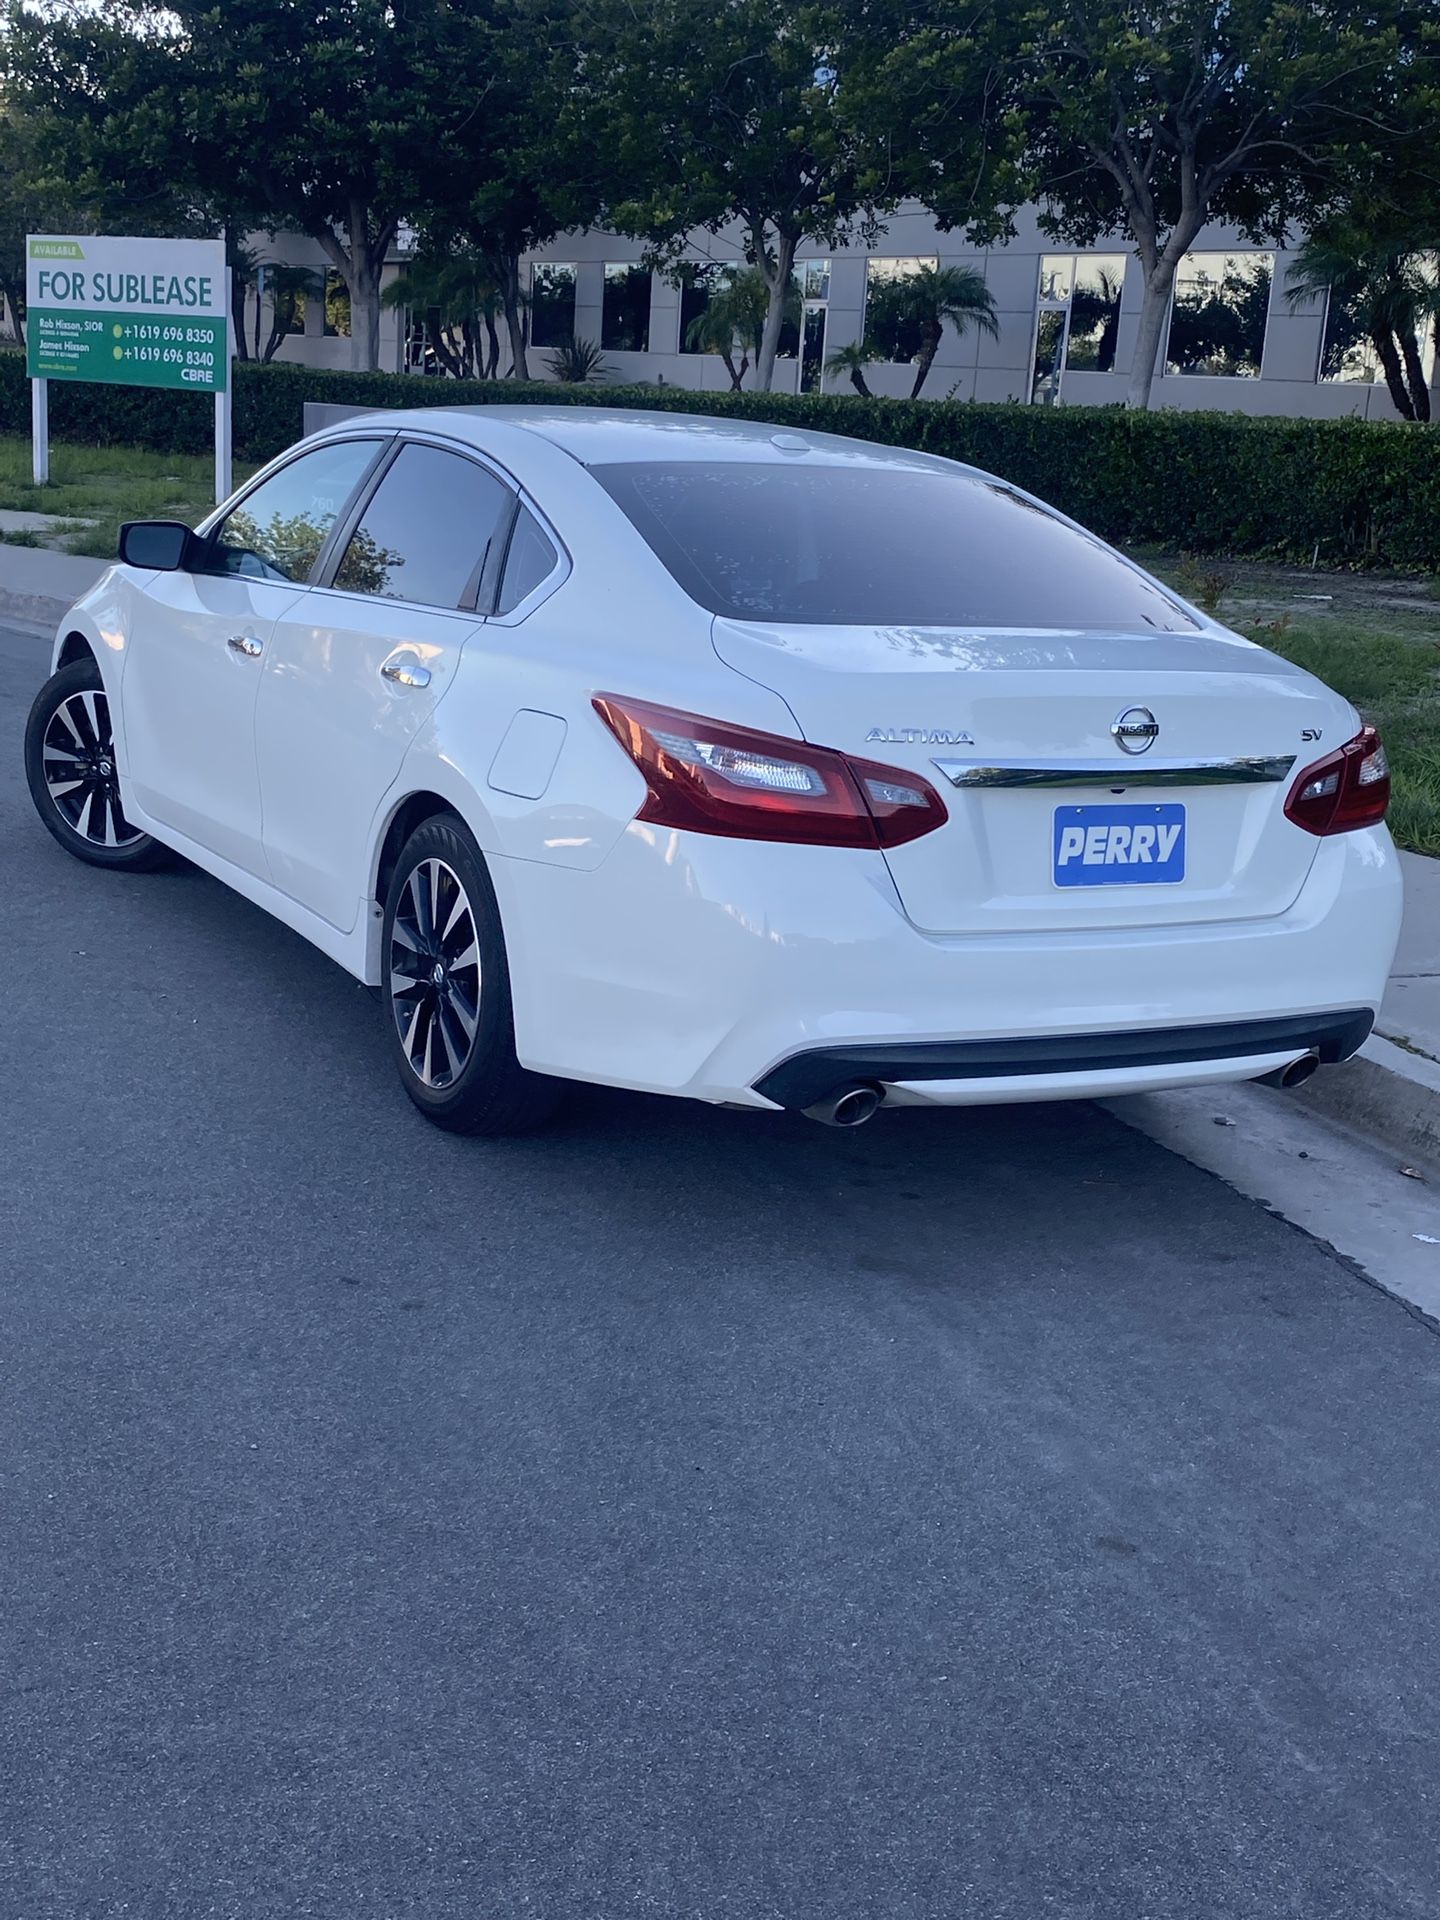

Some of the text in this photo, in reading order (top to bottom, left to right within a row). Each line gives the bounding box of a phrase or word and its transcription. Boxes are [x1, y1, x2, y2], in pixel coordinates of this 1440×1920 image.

[33, 245, 77, 256] AVAILABLE
[38, 271, 212, 307] FOR SUBLEASE
[39, 318, 54, 329] Rob
[84, 321, 104, 332] SIOR
[163, 326, 184, 342] 696
[186, 328, 214, 344] 8350
[39, 339, 63, 350] James
[163, 348, 184, 364] 696
[186, 351, 214, 367] 8340
[181, 368, 214, 383] CBRE
[865, 728, 975, 745] ALTIMA
[1301, 729, 1323, 742] SV
[1057, 824, 1182, 866] PERRY
